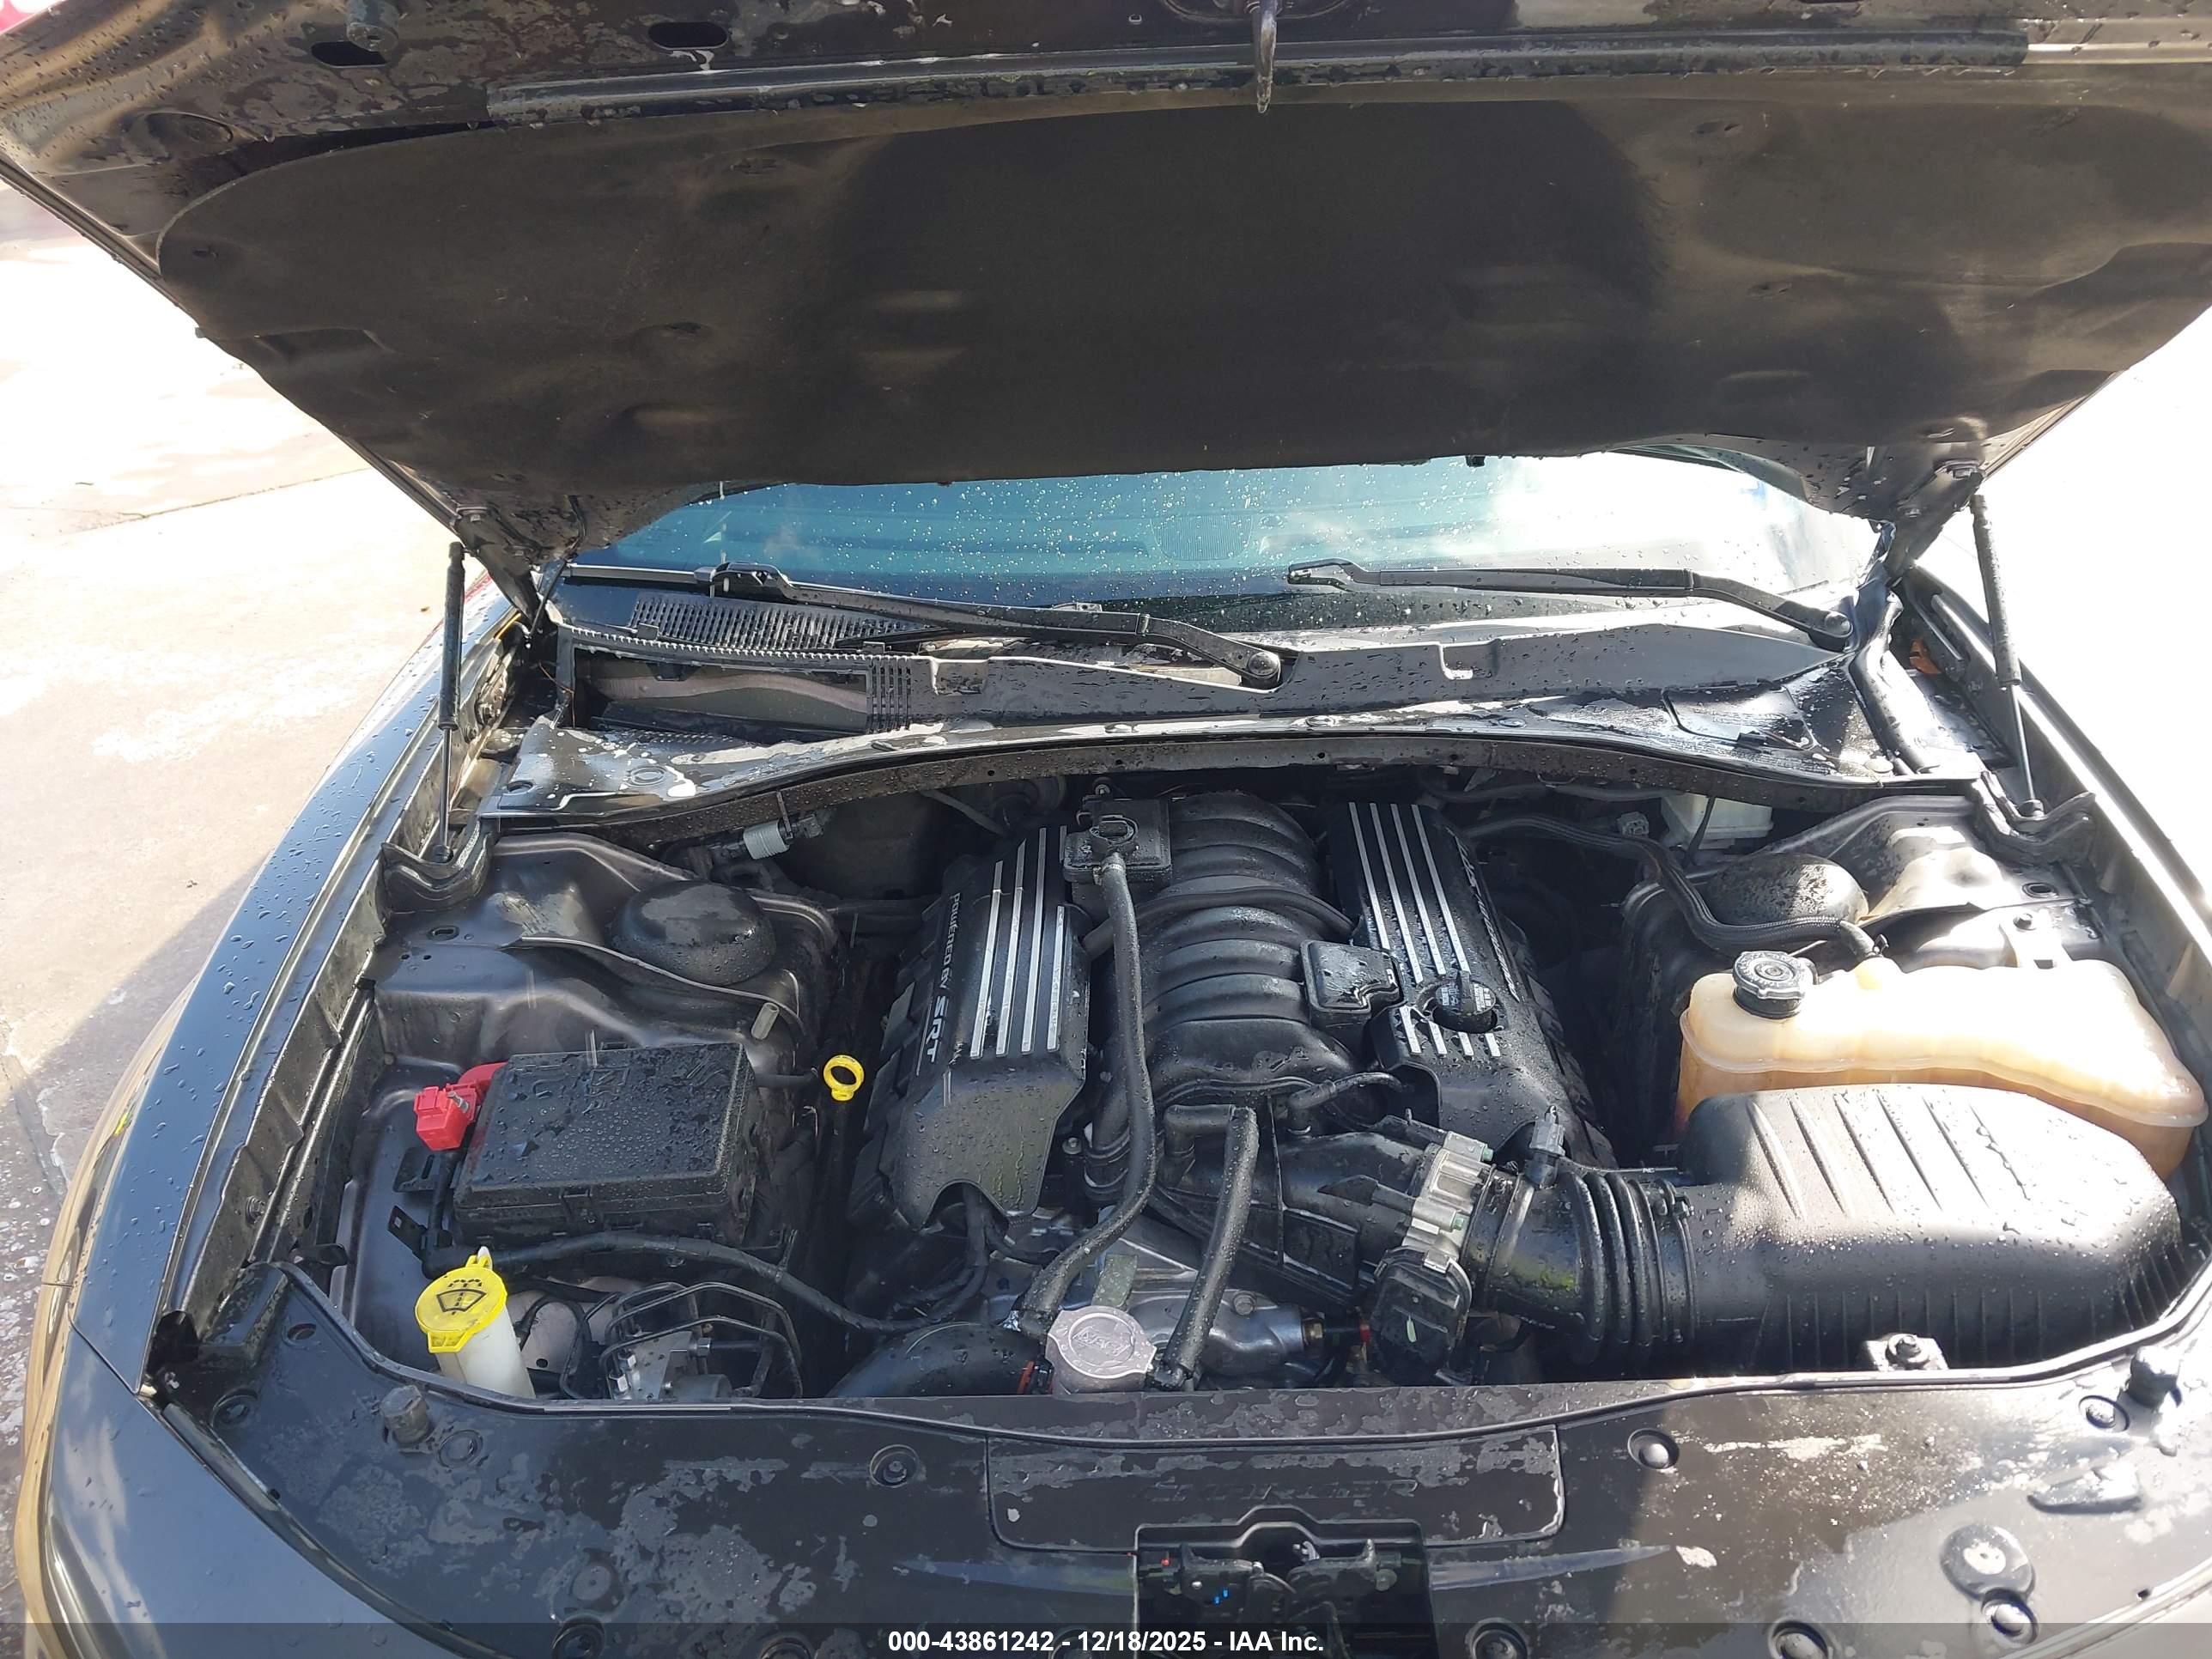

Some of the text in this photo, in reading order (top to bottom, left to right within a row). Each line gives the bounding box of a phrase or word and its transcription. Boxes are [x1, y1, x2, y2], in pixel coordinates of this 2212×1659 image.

[926, 892, 961, 1063] POWERED BY SRT
